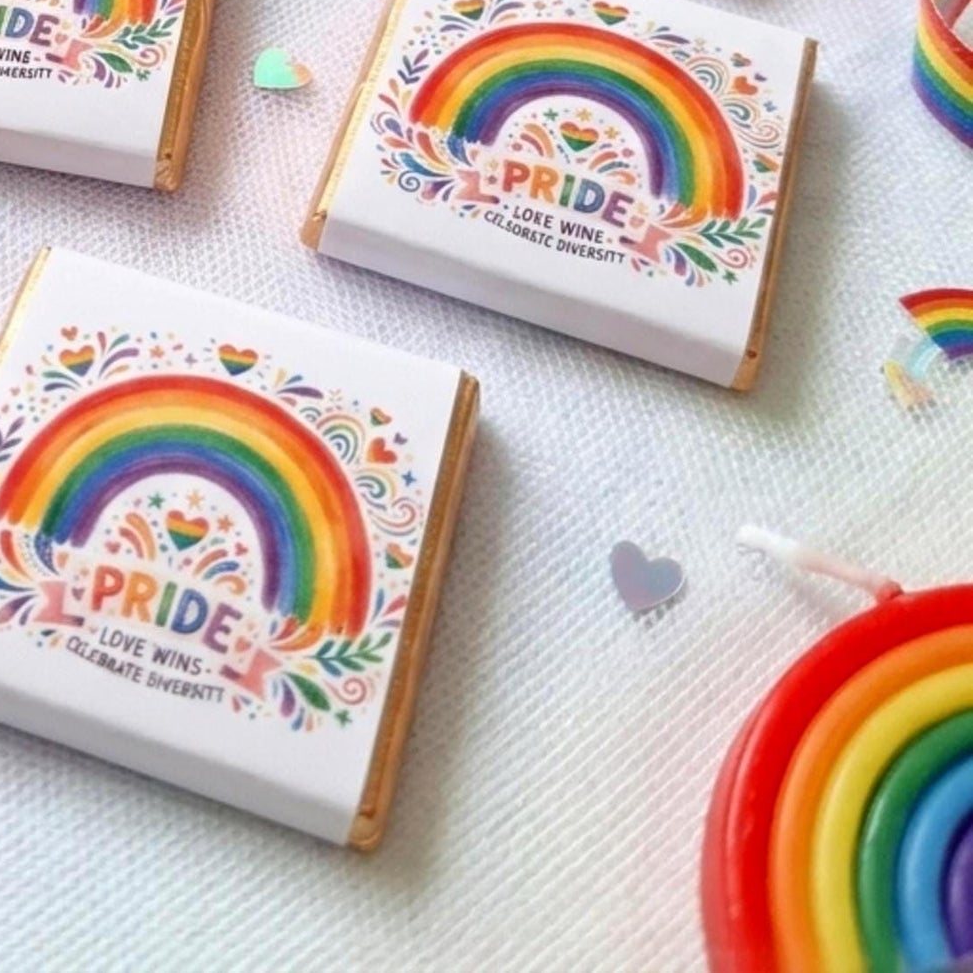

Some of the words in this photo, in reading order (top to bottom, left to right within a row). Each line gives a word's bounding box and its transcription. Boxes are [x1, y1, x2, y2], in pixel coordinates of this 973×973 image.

[502, 159, 634, 228] PRIDE
[560, 219, 605, 244] WINE
[90, 565, 243, 654] PRIDE
[99, 626, 147, 658] LOVE
[152, 644, 202, 675] WINS
